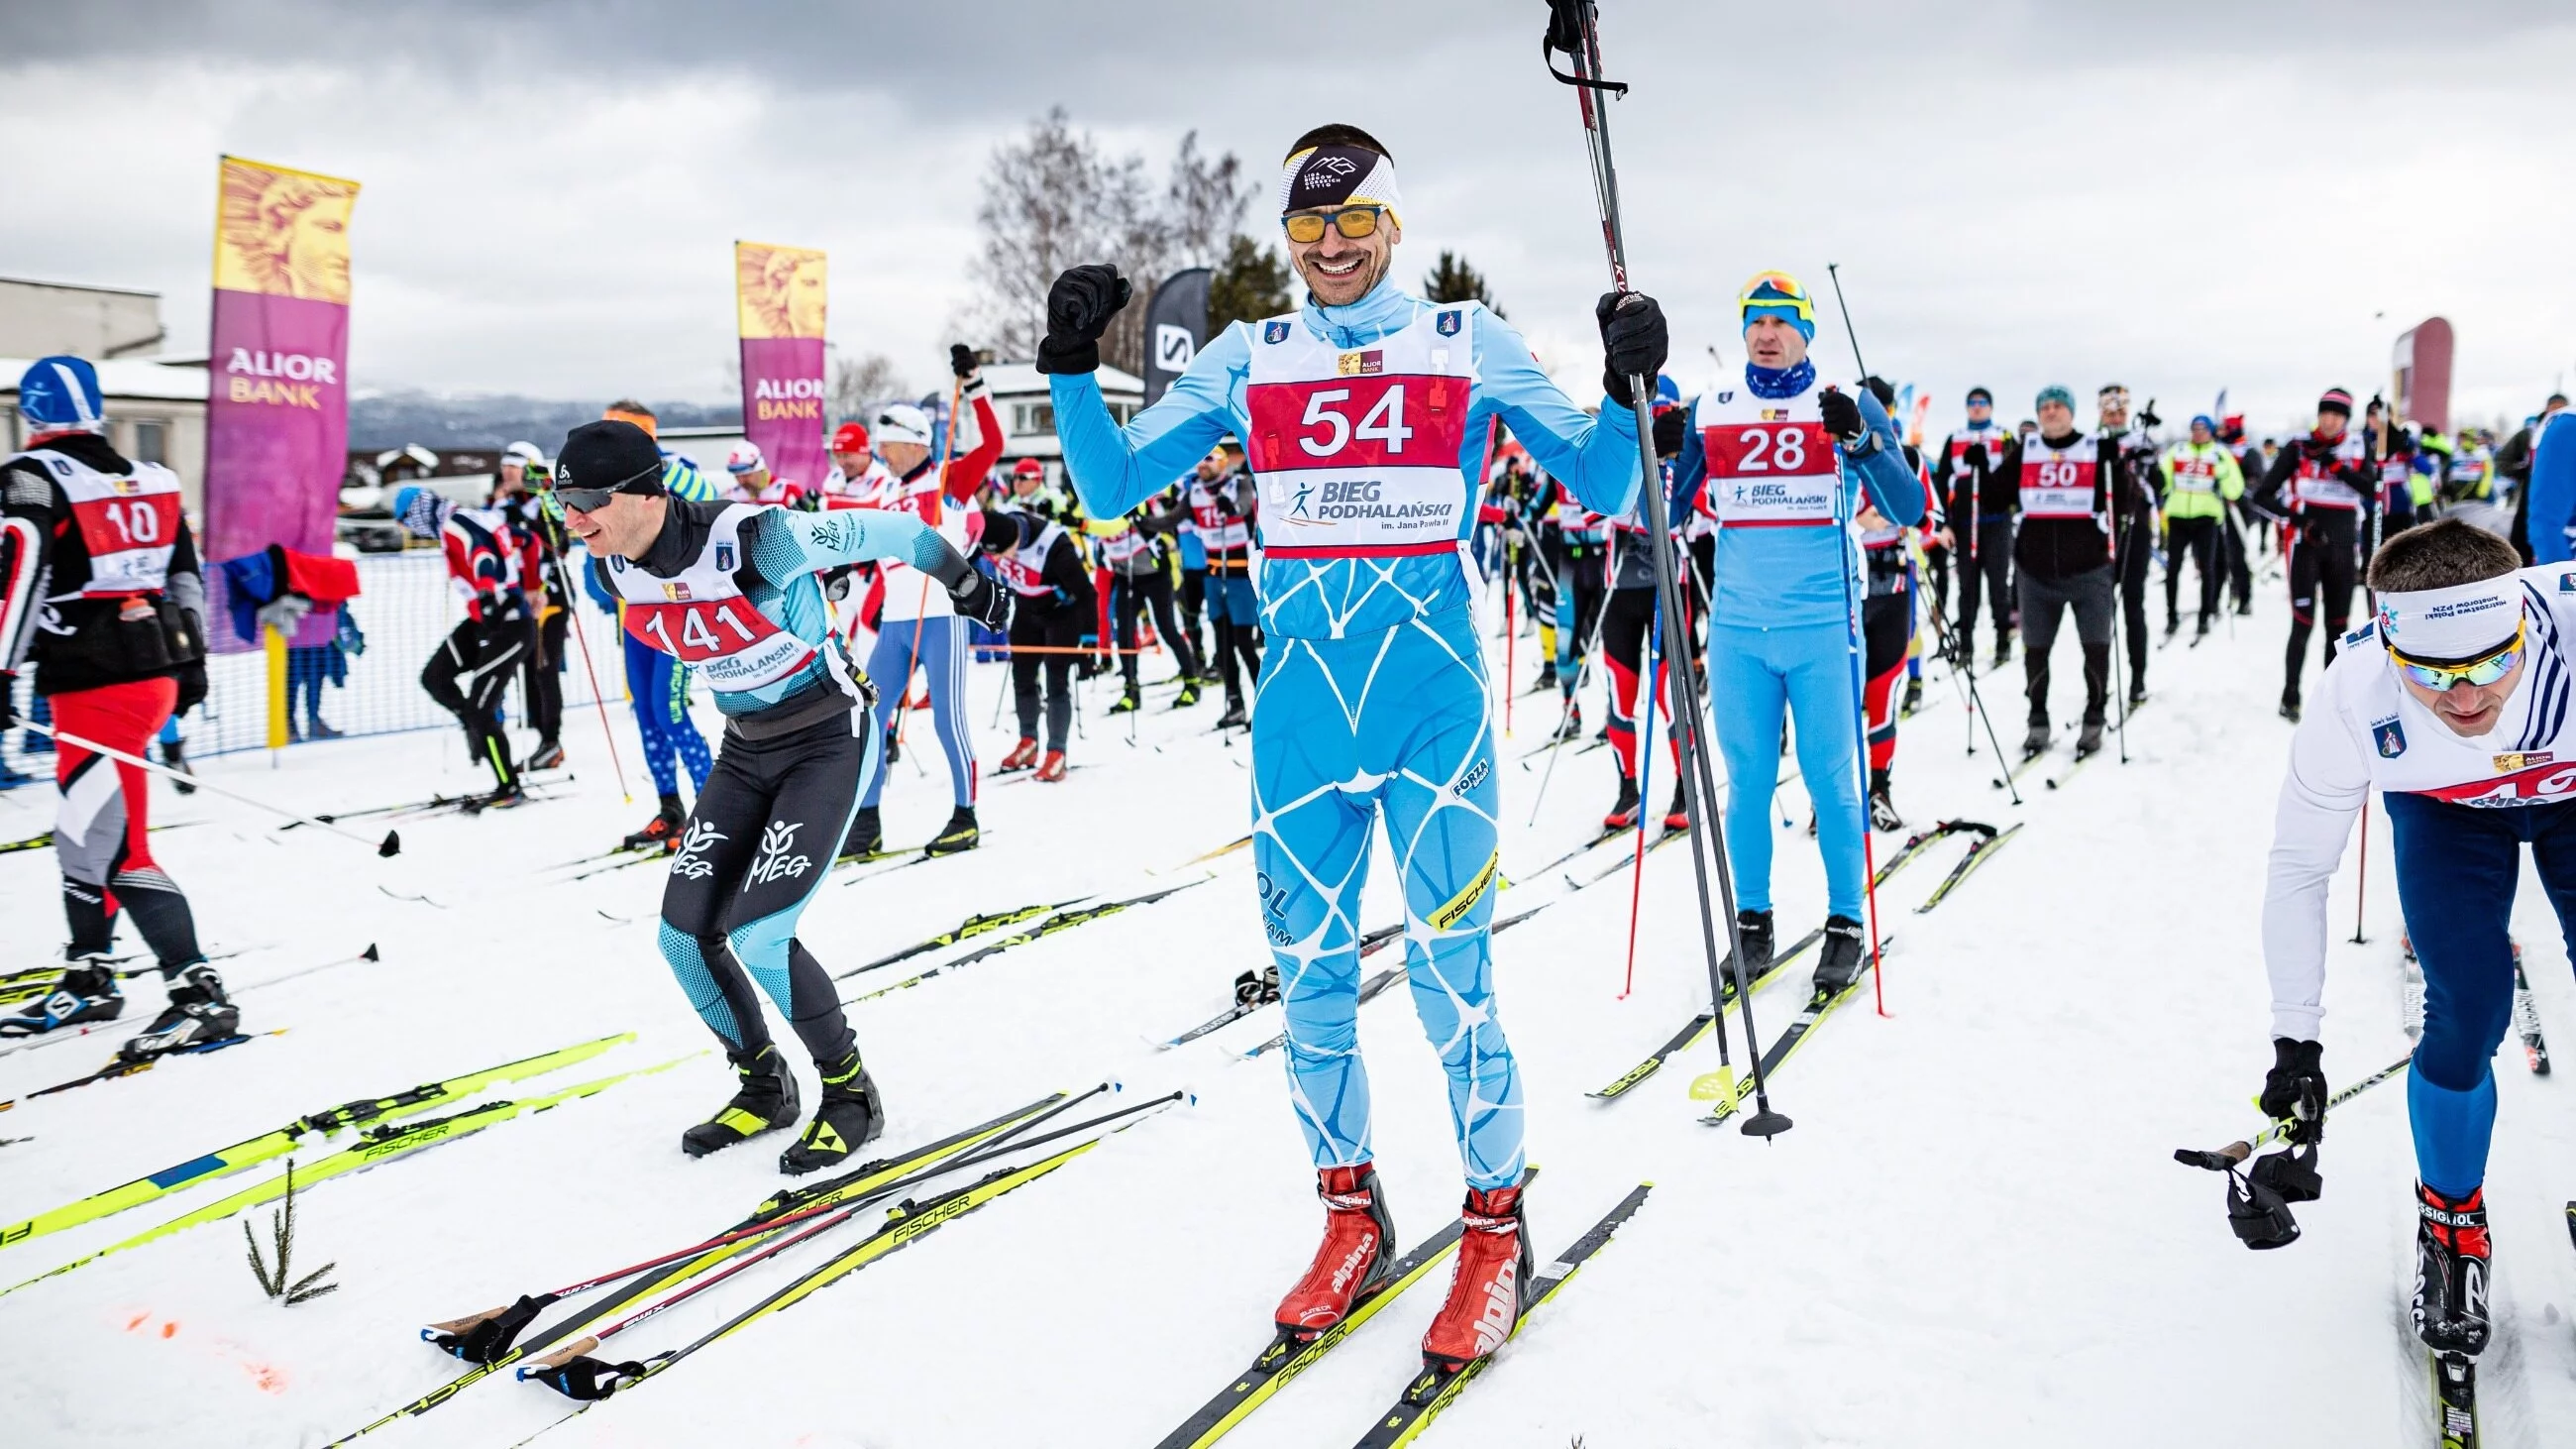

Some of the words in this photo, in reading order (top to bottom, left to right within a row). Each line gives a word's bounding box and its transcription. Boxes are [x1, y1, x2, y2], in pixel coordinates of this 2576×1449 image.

[226, 347, 338, 385] ALIOR
[230, 377, 322, 410] BANK
[758, 400, 818, 420] BANK
[1299, 384, 1413, 457] 54
[1737, 427, 1805, 472] 28
[1321, 481, 1381, 502] BIEG
[1752, 484, 1785, 497] BIEG
[2039, 463, 2078, 487] 50
[105, 502, 159, 544] 10
[1319, 501, 1452, 519] PODHALAŃSKI
[646, 605, 757, 657] 141
[2424, 611, 2455, 620] Polski
[1453, 760, 1487, 796] FORZA
[744, 854, 811, 892] MEG
[1440, 864, 1496, 930] FISCHER
[363, 1125, 450, 1162] FISCHER
[1334, 1194, 1372, 1205] alpina
[893, 1195, 970, 1243] FISCHER
[1331, 1232, 1375, 1294] alpina
[623, 1302, 667, 1329] SWIX
[1276, 1322, 1347, 1391] FISCHER
